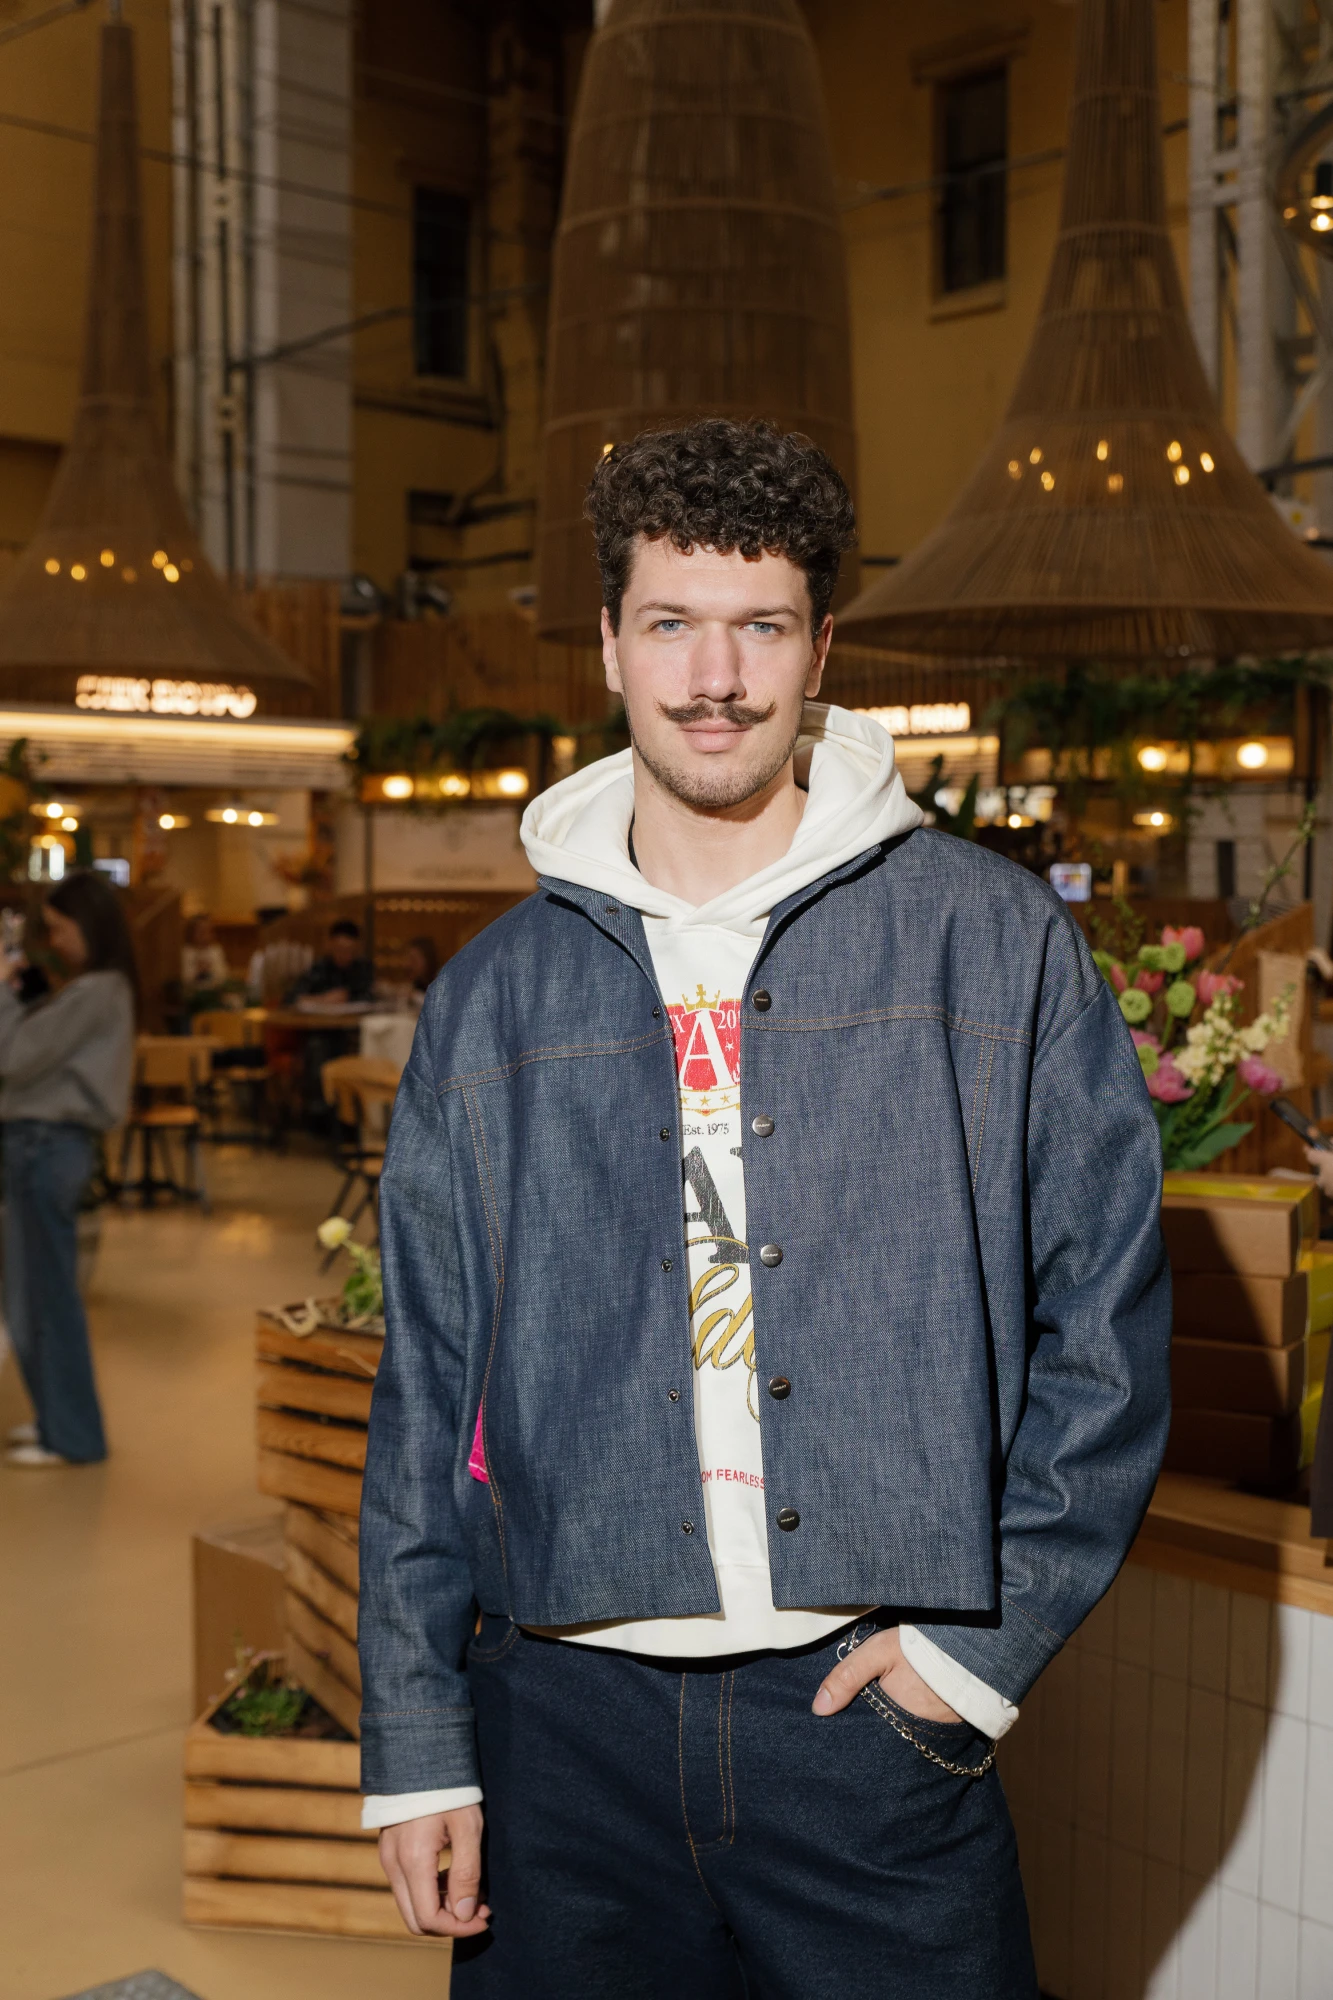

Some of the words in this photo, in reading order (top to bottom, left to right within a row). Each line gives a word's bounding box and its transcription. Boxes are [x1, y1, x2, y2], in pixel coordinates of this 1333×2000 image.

[683, 1124, 704, 1135] Est.
[707, 1122, 729, 1135] 1975
[716, 1469, 764, 1490] FEARLESS
